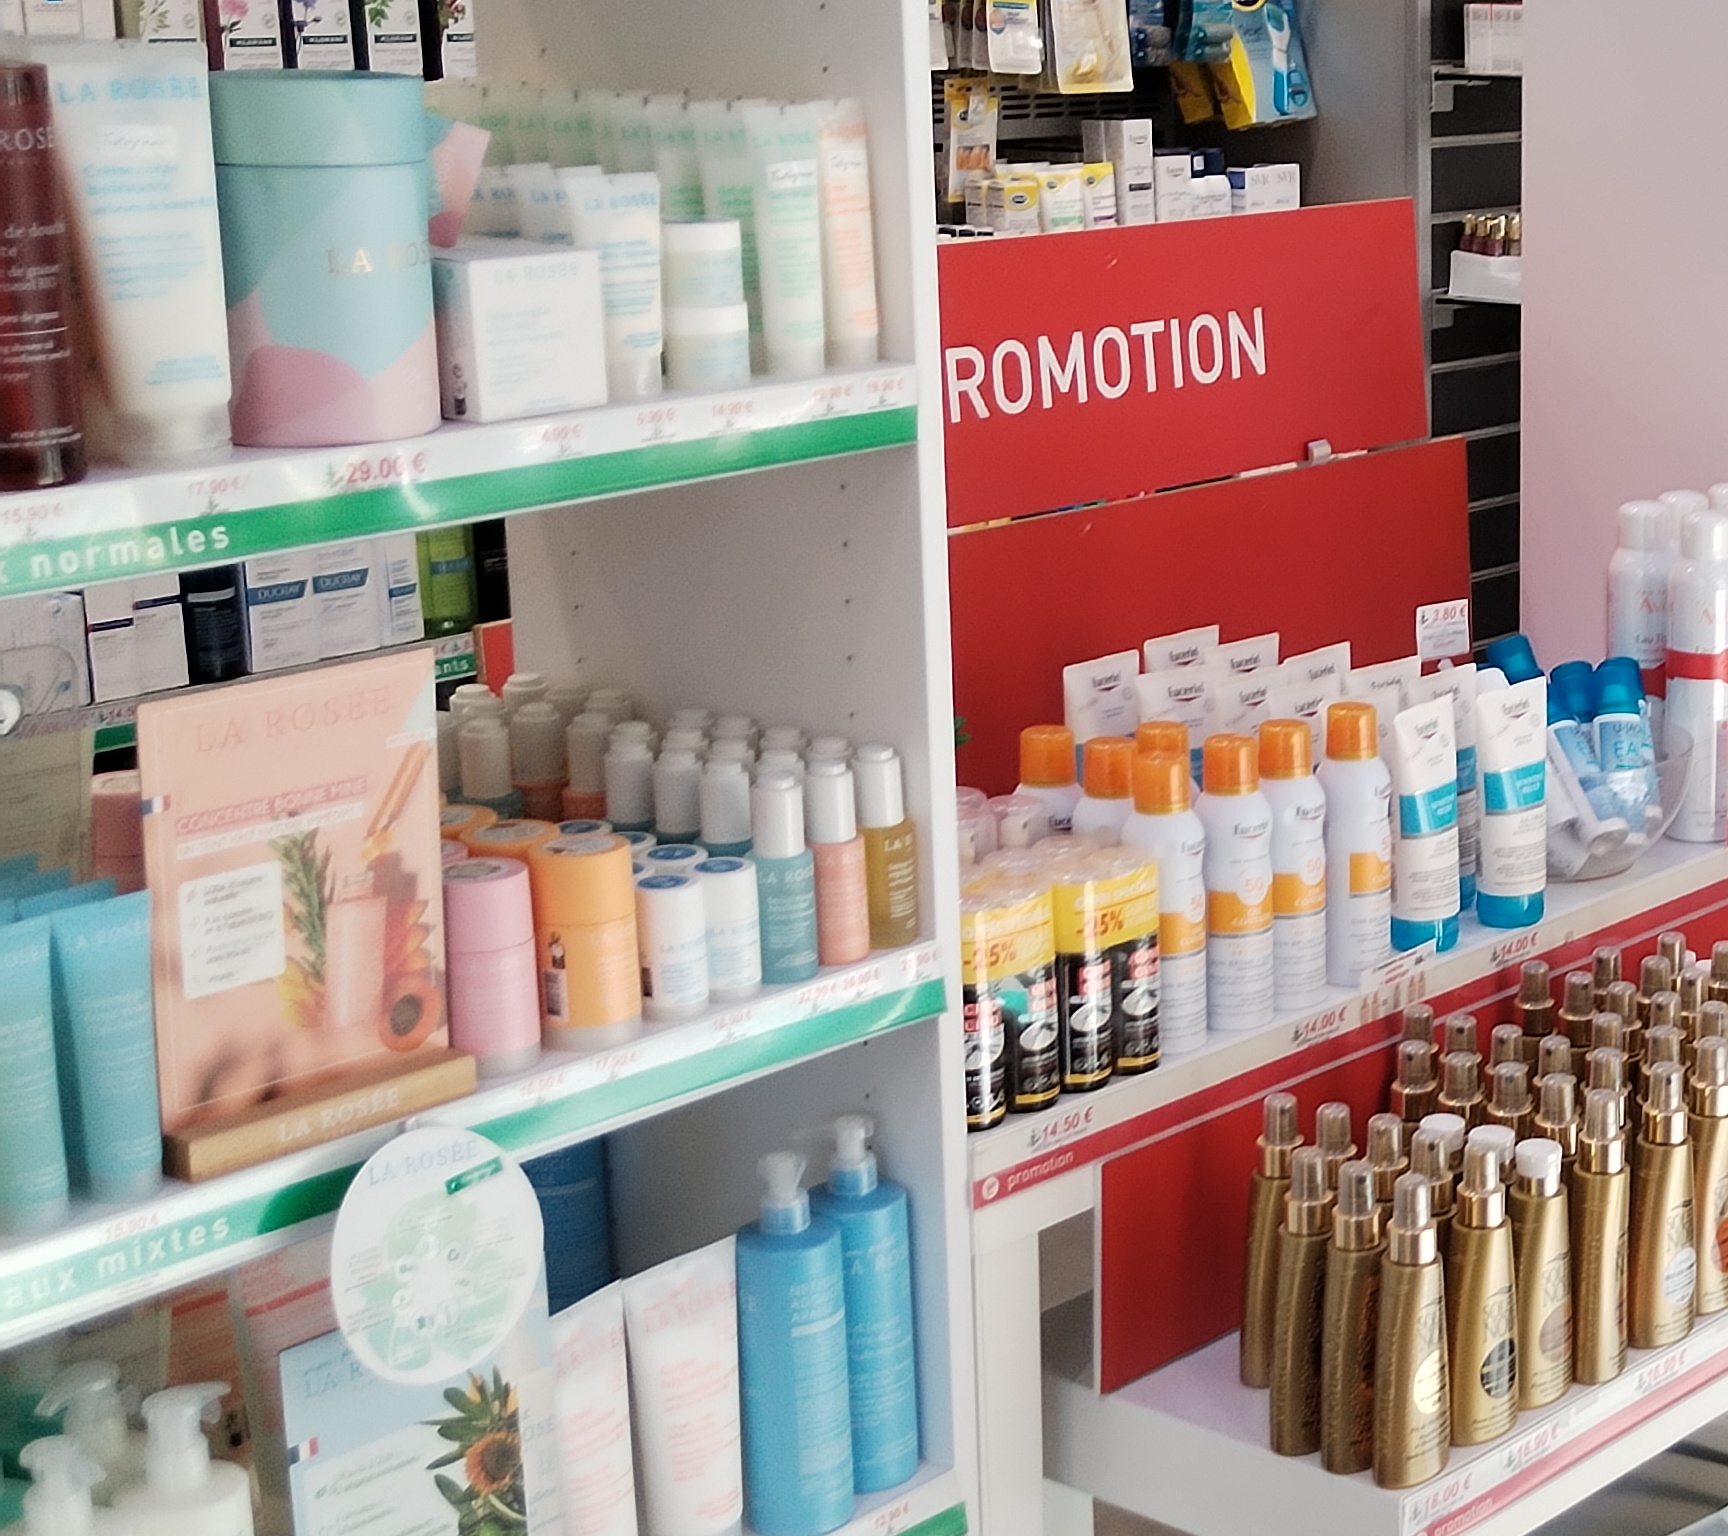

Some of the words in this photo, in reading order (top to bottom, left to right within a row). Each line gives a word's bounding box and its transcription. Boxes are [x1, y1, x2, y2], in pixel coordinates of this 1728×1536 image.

[945, 307, 1266, 423] ROMOTION
[347, 457, 402, 484] 29.00
[413, 451, 427, 475] €
[30, 523, 230, 578] normales
[266, 684, 393, 739] ROSÉE
[1499, 933, 1528, 958] 14.00
[1303, 1014, 1333, 1040] 14.00
[1336, 1007, 1346, 1022] €
[279, 1119, 312, 1143] LA
[321, 1088, 400, 1130] ROSÉE
[1042, 1112, 1079, 1141] 14.50
[1007, 1150, 1073, 1191] promotion
[4, 1264, 77, 1309] aux
[97, 1216, 230, 1279] mixtes
[1516, 1428, 1548, 1460] 16.90
[1422, 1480, 1459, 1510] 18.00
